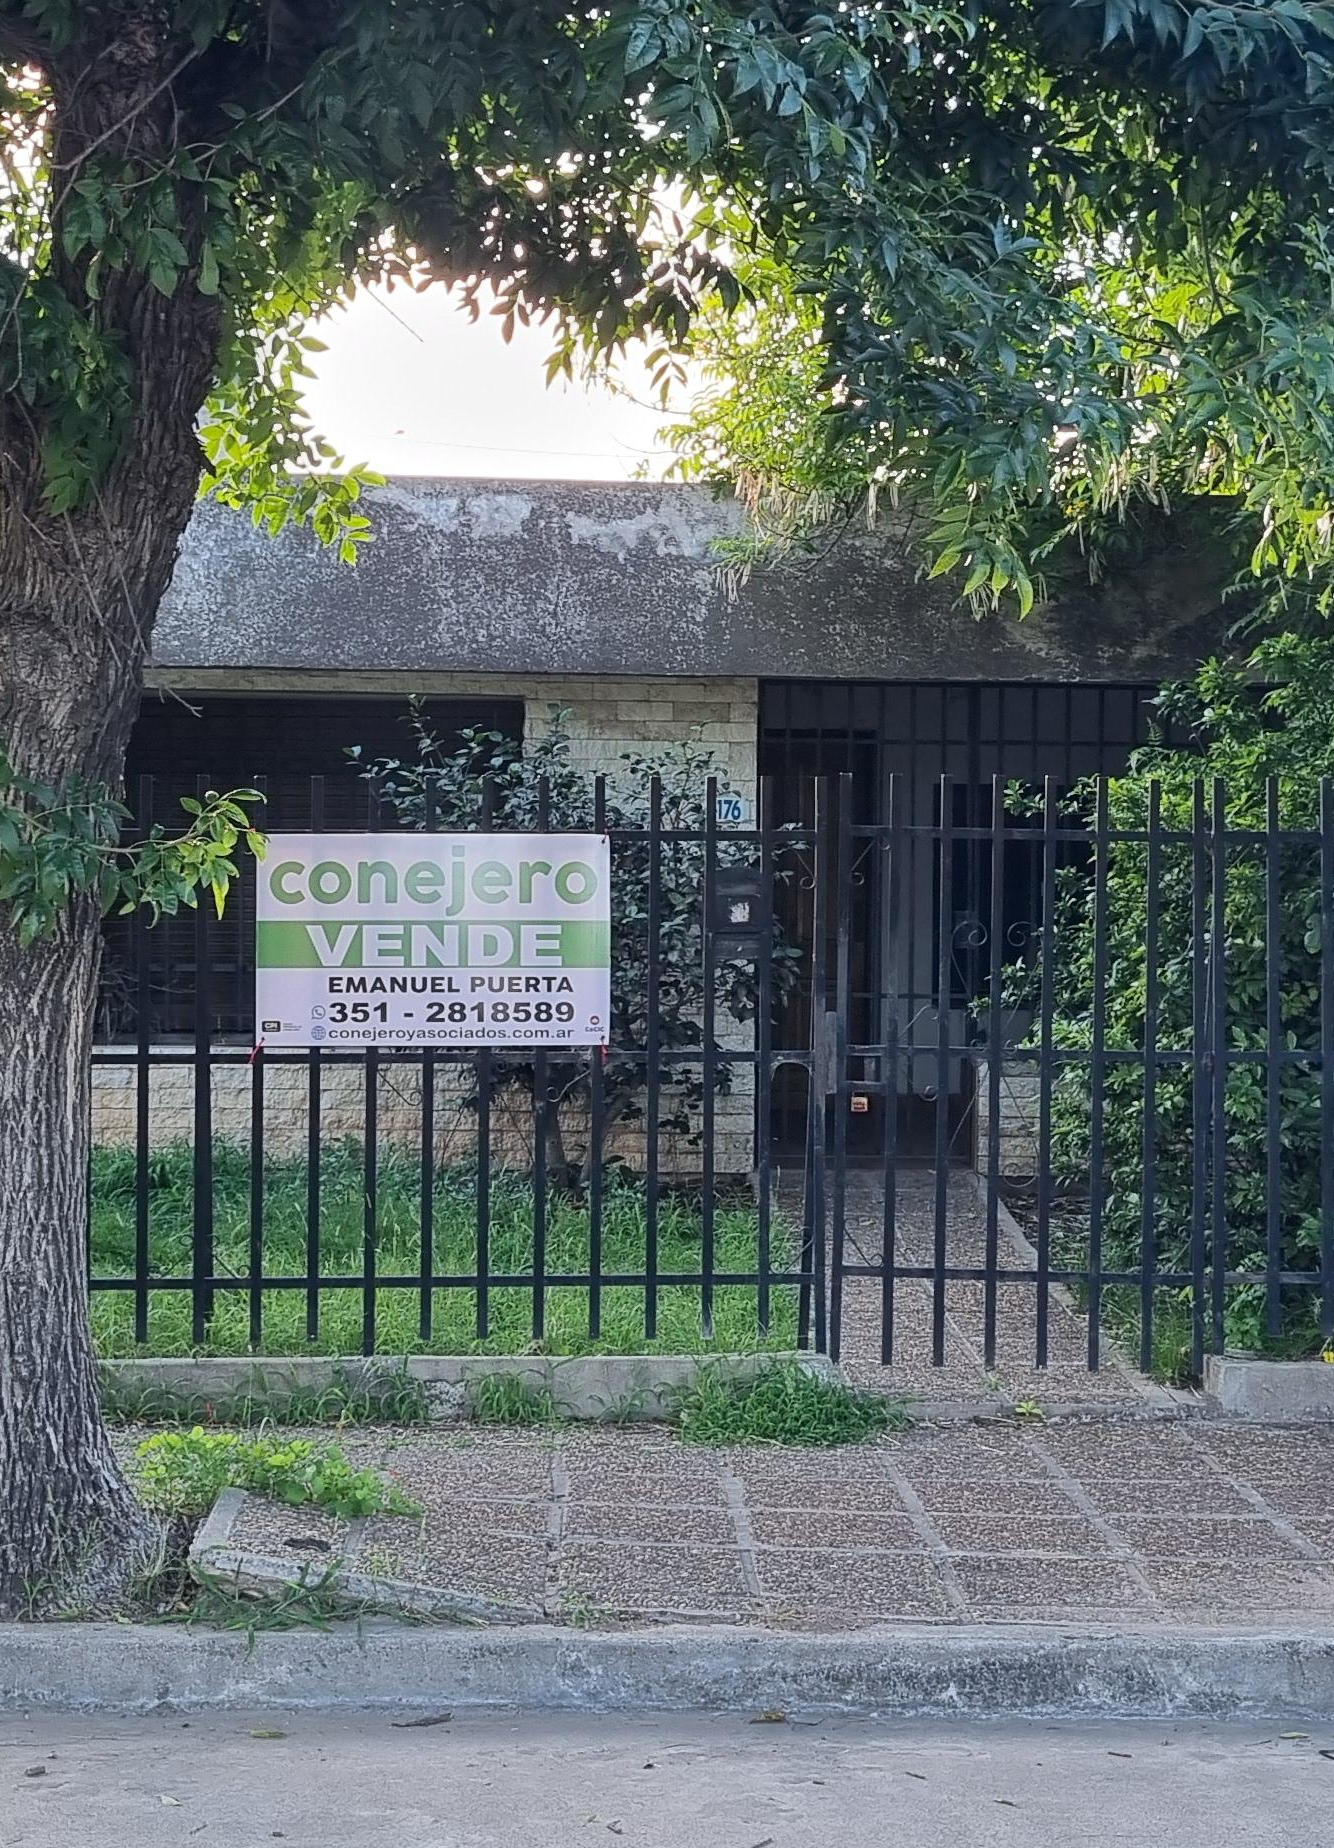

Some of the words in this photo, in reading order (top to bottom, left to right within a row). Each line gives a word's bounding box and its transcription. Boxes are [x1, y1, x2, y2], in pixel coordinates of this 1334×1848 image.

[268, 844, 599, 917] conejero
[305, 924, 563, 968] VENDE
[328, 976, 461, 994] EMANUEL
[470, 976, 575, 994] PUERTA
[328, 1001, 388, 1023] 351
[425, 1001, 575, 1023] 2818589
[328, 1026, 576, 1042] conejeroyasociados.com.ar
